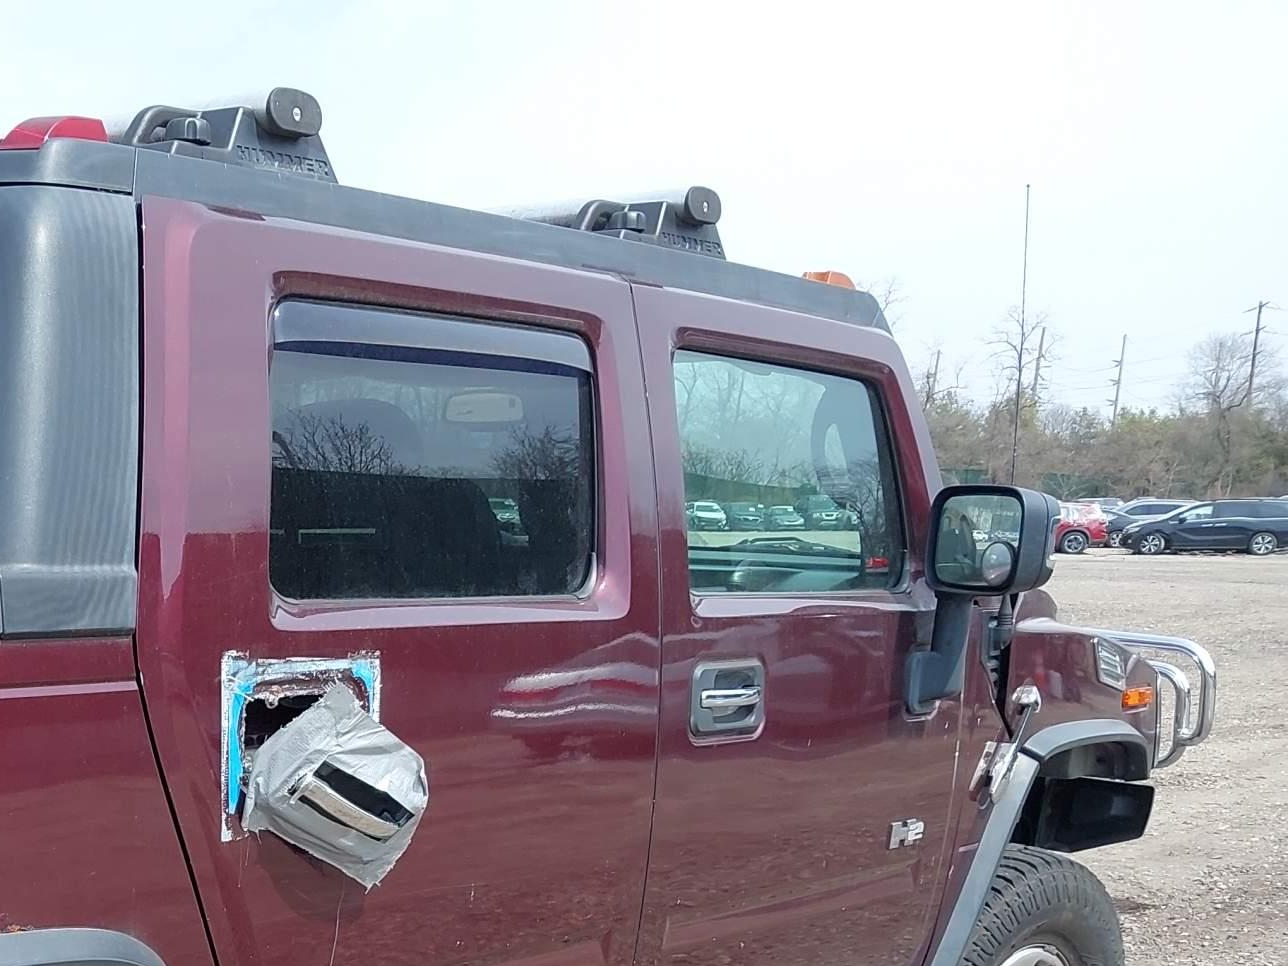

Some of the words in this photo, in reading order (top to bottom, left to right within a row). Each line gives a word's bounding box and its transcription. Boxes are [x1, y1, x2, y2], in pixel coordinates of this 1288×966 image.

[235, 144, 330, 177] HUMMER
[661, 231, 722, 255] HUMMER
[888, 818, 925, 850] H2
